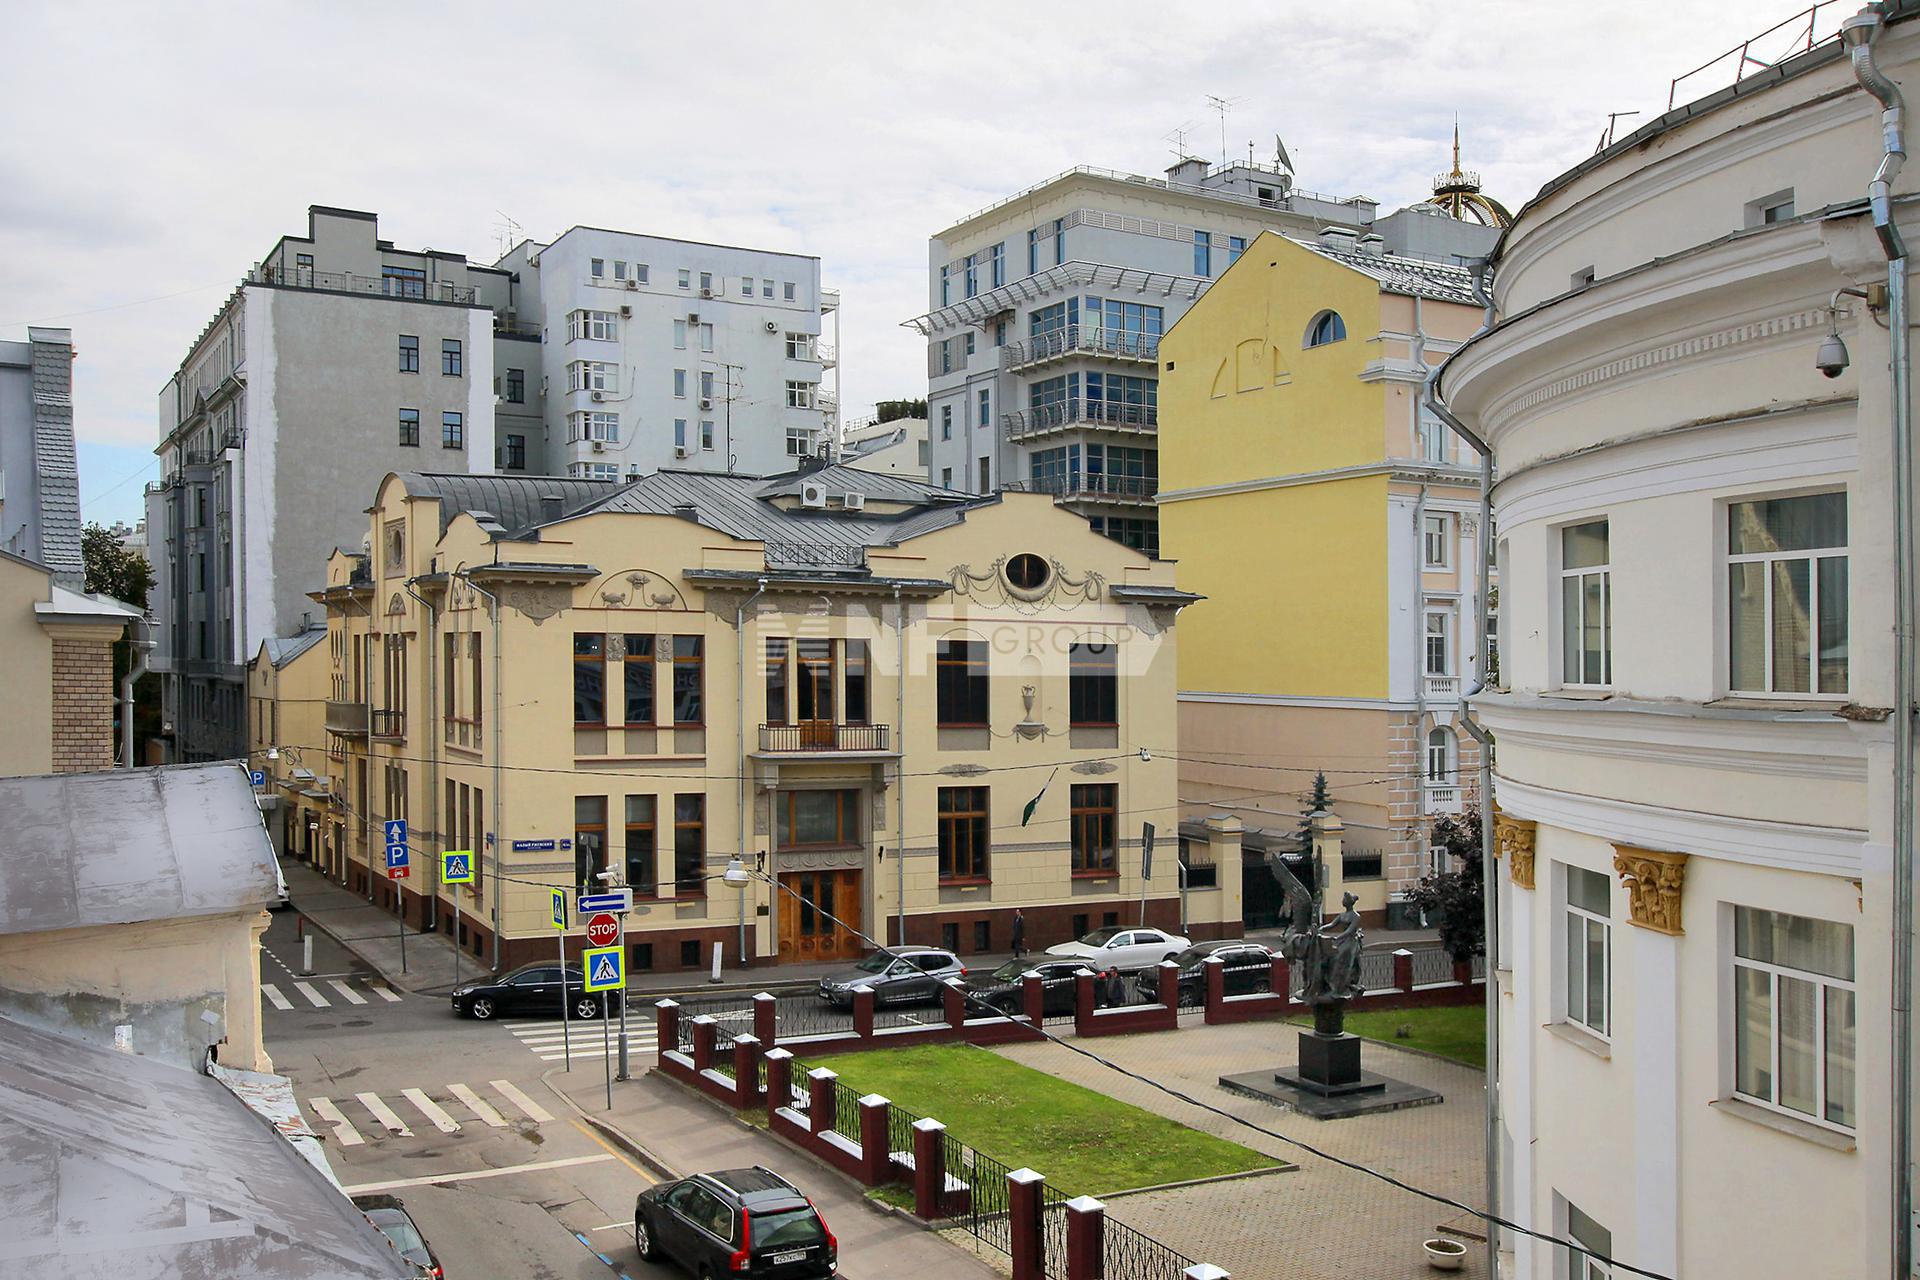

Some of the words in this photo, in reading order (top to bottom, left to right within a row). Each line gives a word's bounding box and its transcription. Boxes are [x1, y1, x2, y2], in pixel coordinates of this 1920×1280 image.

[253, 772, 263, 783] P
[392, 846, 404, 864] P
[589, 923, 617, 936] STOP
